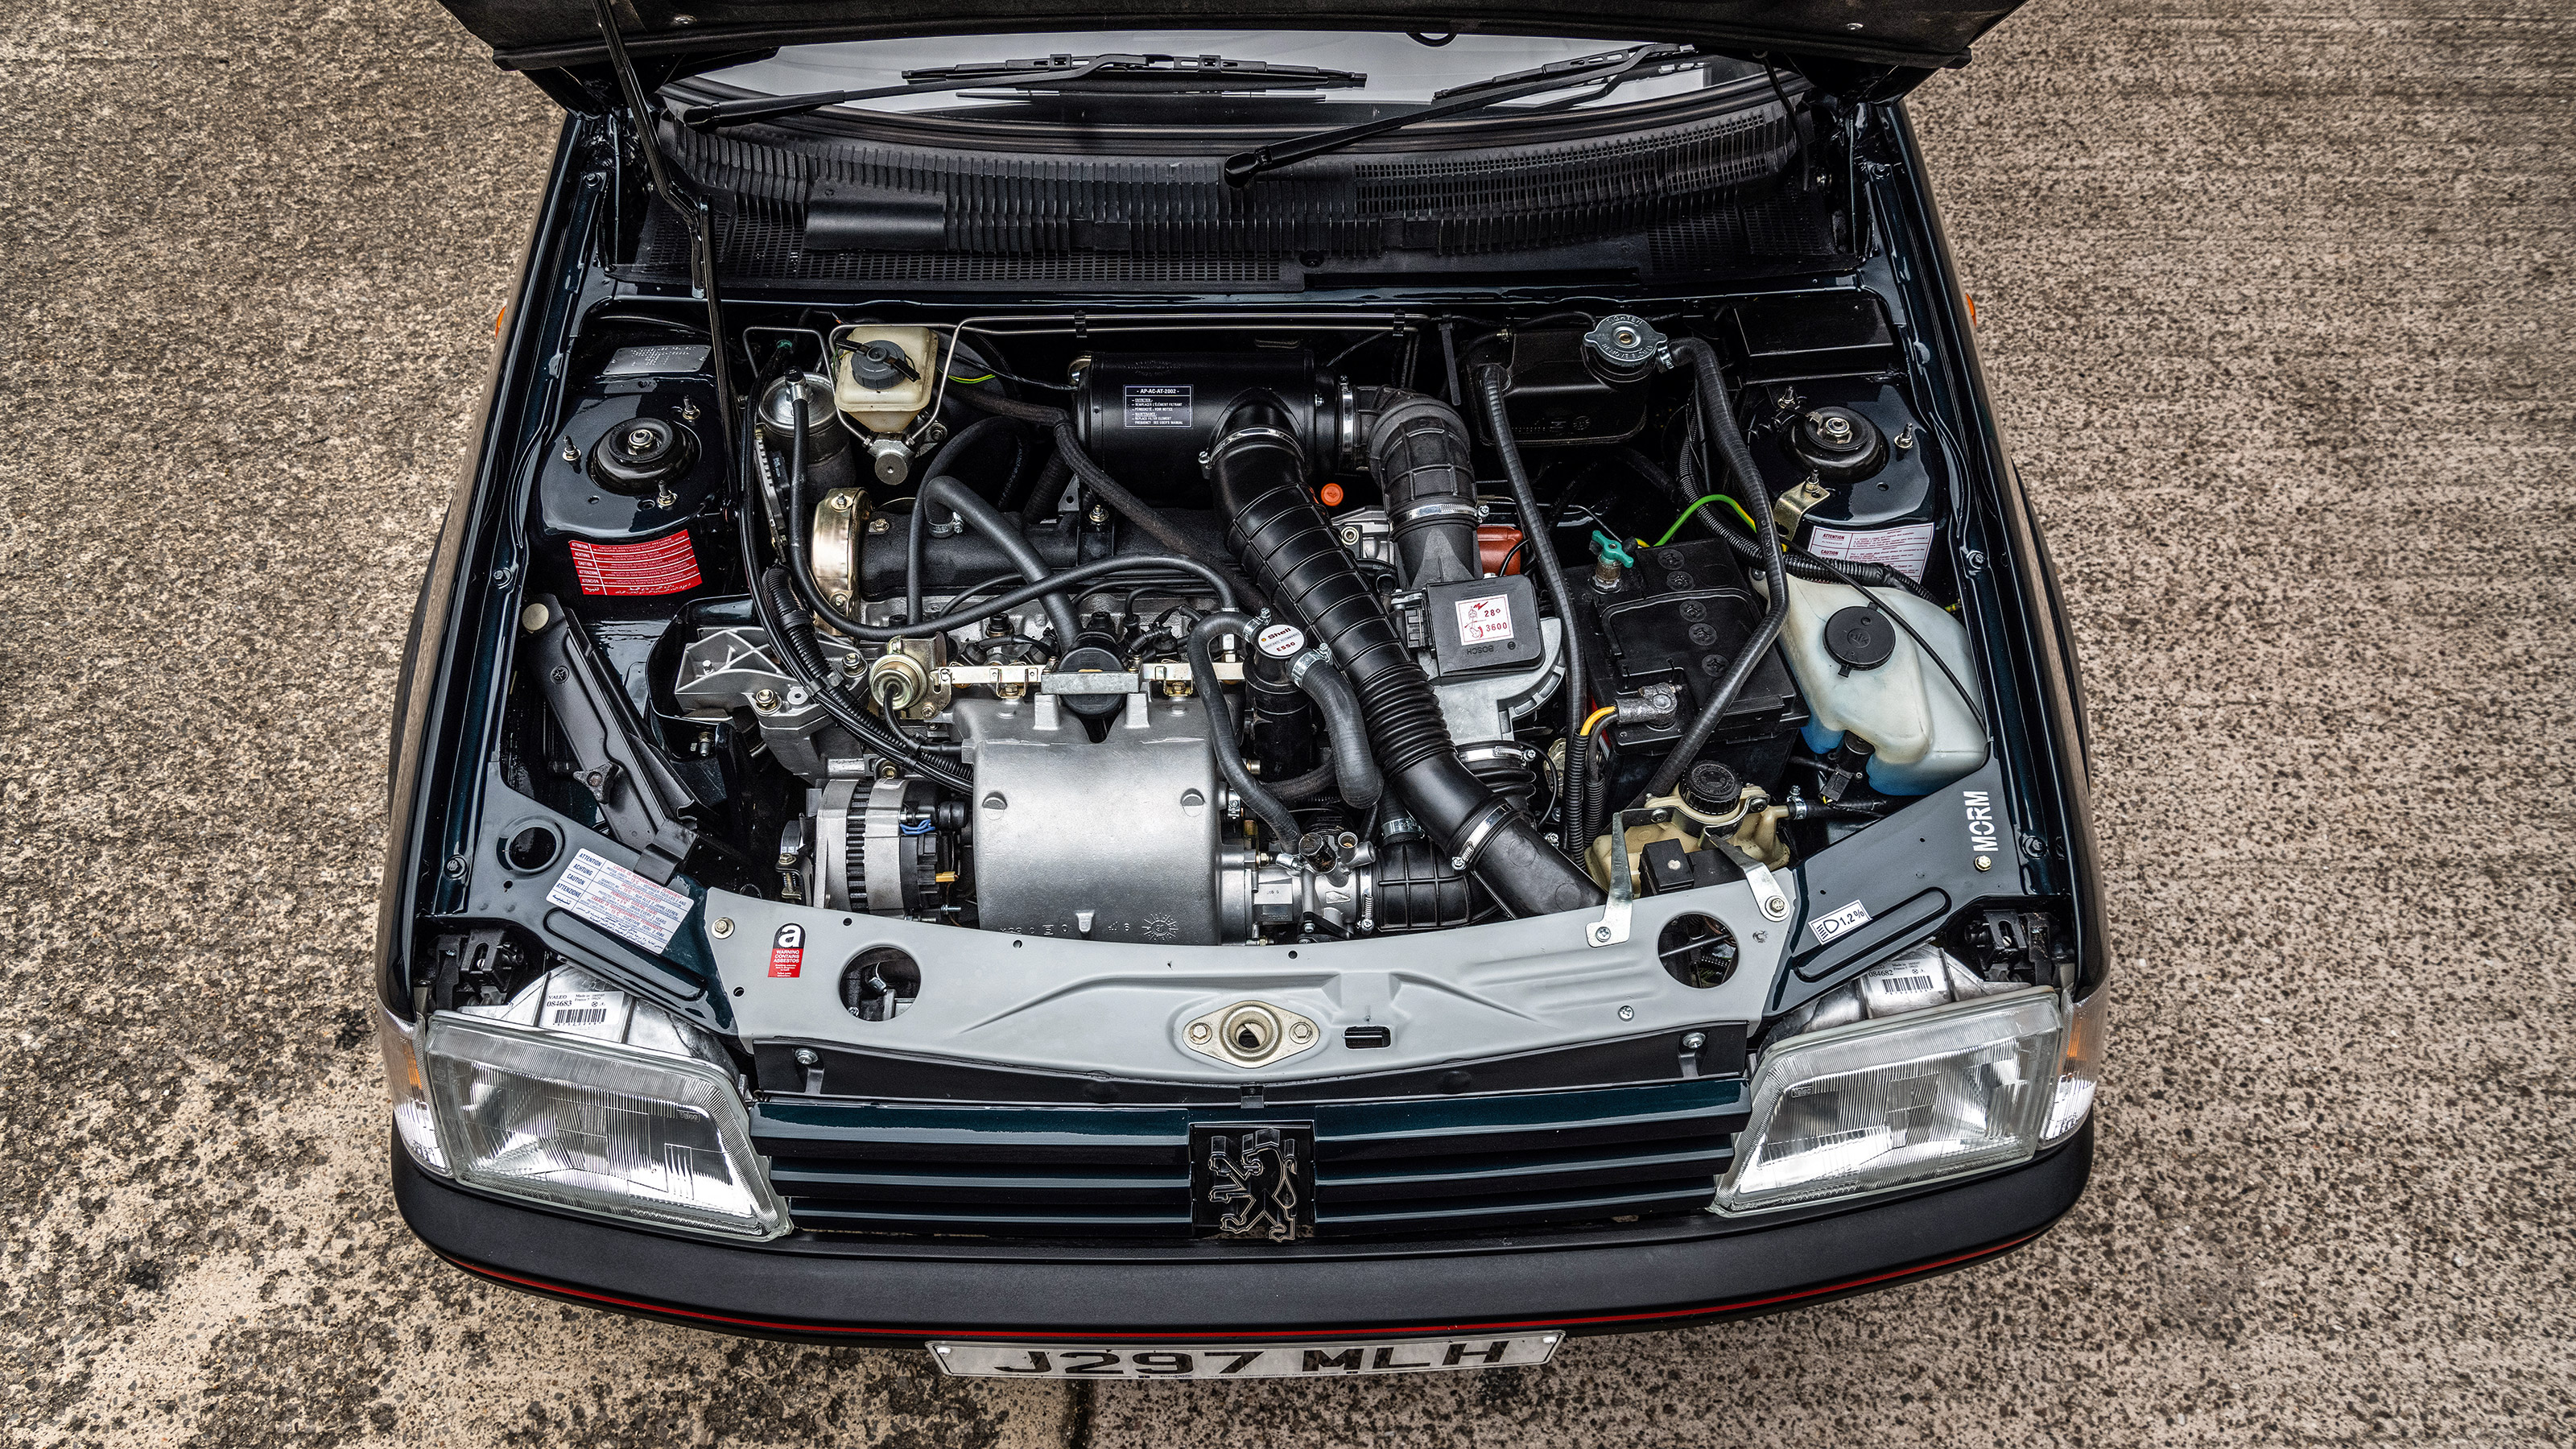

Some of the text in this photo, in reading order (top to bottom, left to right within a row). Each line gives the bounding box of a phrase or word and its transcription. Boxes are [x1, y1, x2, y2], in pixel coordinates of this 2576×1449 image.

[1486, 622, 1507, 632] 3600
[1268, 627, 1291, 640] Shell
[1276, 642, 1295, 652] ESSO
[1467, 646, 1494, 655] BOSCH
[1963, 791, 1998, 851] MORM
[578, 853, 602, 867] ATTENTION
[573, 863, 594, 876] ACHTUNG
[566, 874, 586, 886] CAUTION
[556, 882, 582, 898] ATTENZIONE
[662, 888, 683, 900] PERMANENT
[630, 900, 646, 910] COOLING
[778, 925, 801, 948] a
[1868, 970, 1894, 978] 084682
[991, 1340, 1510, 1375] J297 MLH
